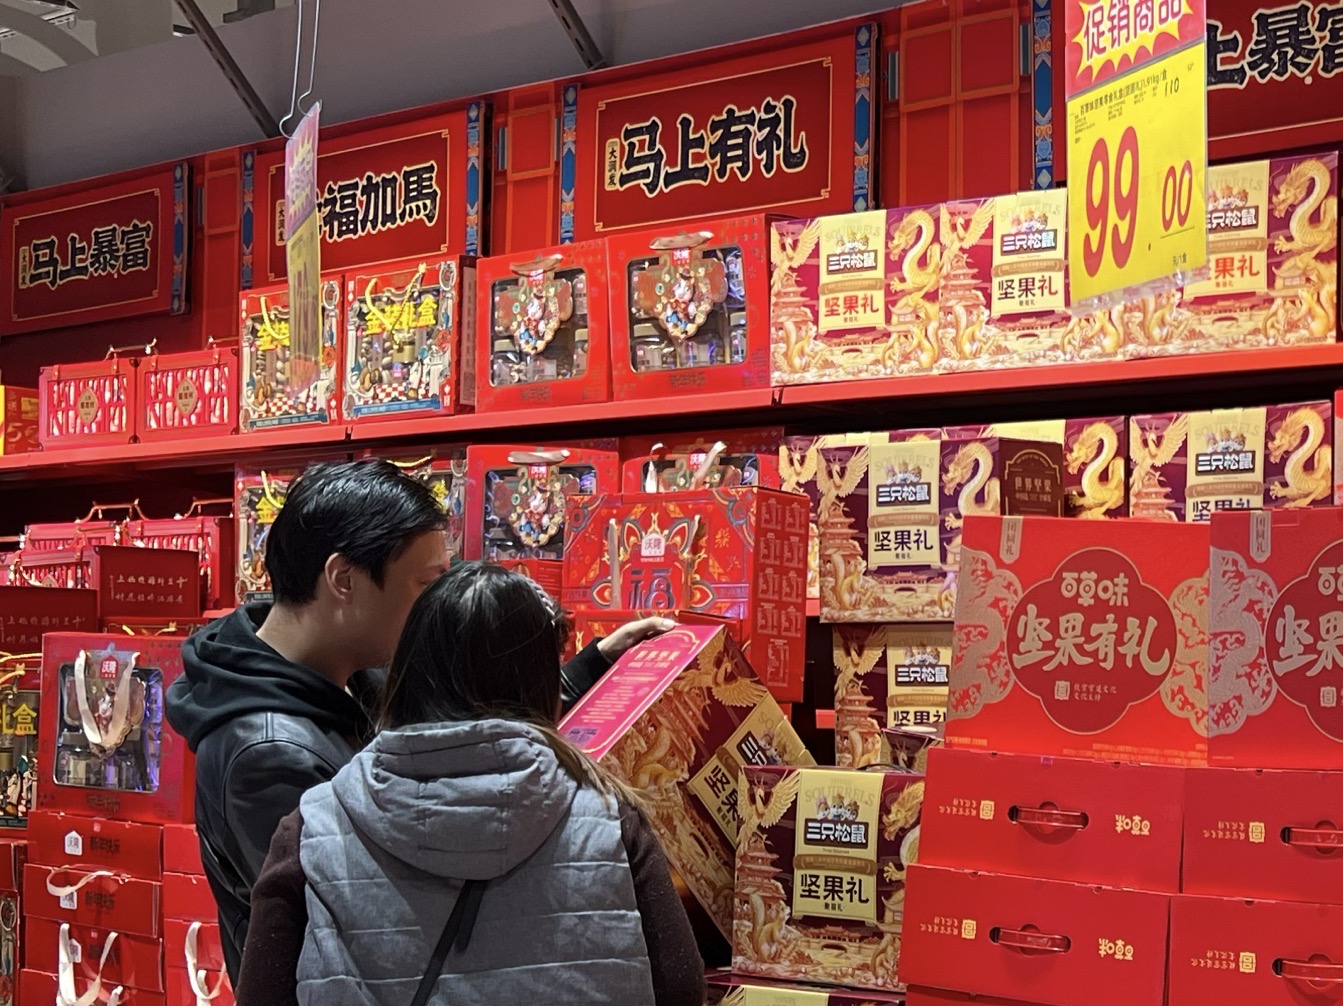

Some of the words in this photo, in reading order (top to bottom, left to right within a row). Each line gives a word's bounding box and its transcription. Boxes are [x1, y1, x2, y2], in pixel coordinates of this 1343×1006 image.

[618, 95, 808, 198] 马上有礼
[316, 160, 441, 242] 福加馬
[1002, 229, 1055, 251] 三只松鼠
[29, 219, 152, 290] 马上暴富
[828, 252, 876, 271] 三只松鼠
[998, 275, 1058, 301] 坚果礼
[824, 293, 879, 317] 坚果礼
[1197, 452, 1255, 473] 三只松鼠
[878, 484, 929, 503] 三只松鼠
[874, 527, 934, 553] 坚果礼
[1061, 571, 1130, 606] 百草味
[1012, 604, 1170, 675] 坚果有礼
[897, 665, 948, 685] 三只松鼠
[806, 820, 866, 844] 三只松鼠
[1115, 815, 1151, 836] 百草味
[800, 873, 869, 904] 坚果礼
[1099, 938, 1134, 960] 百草味
